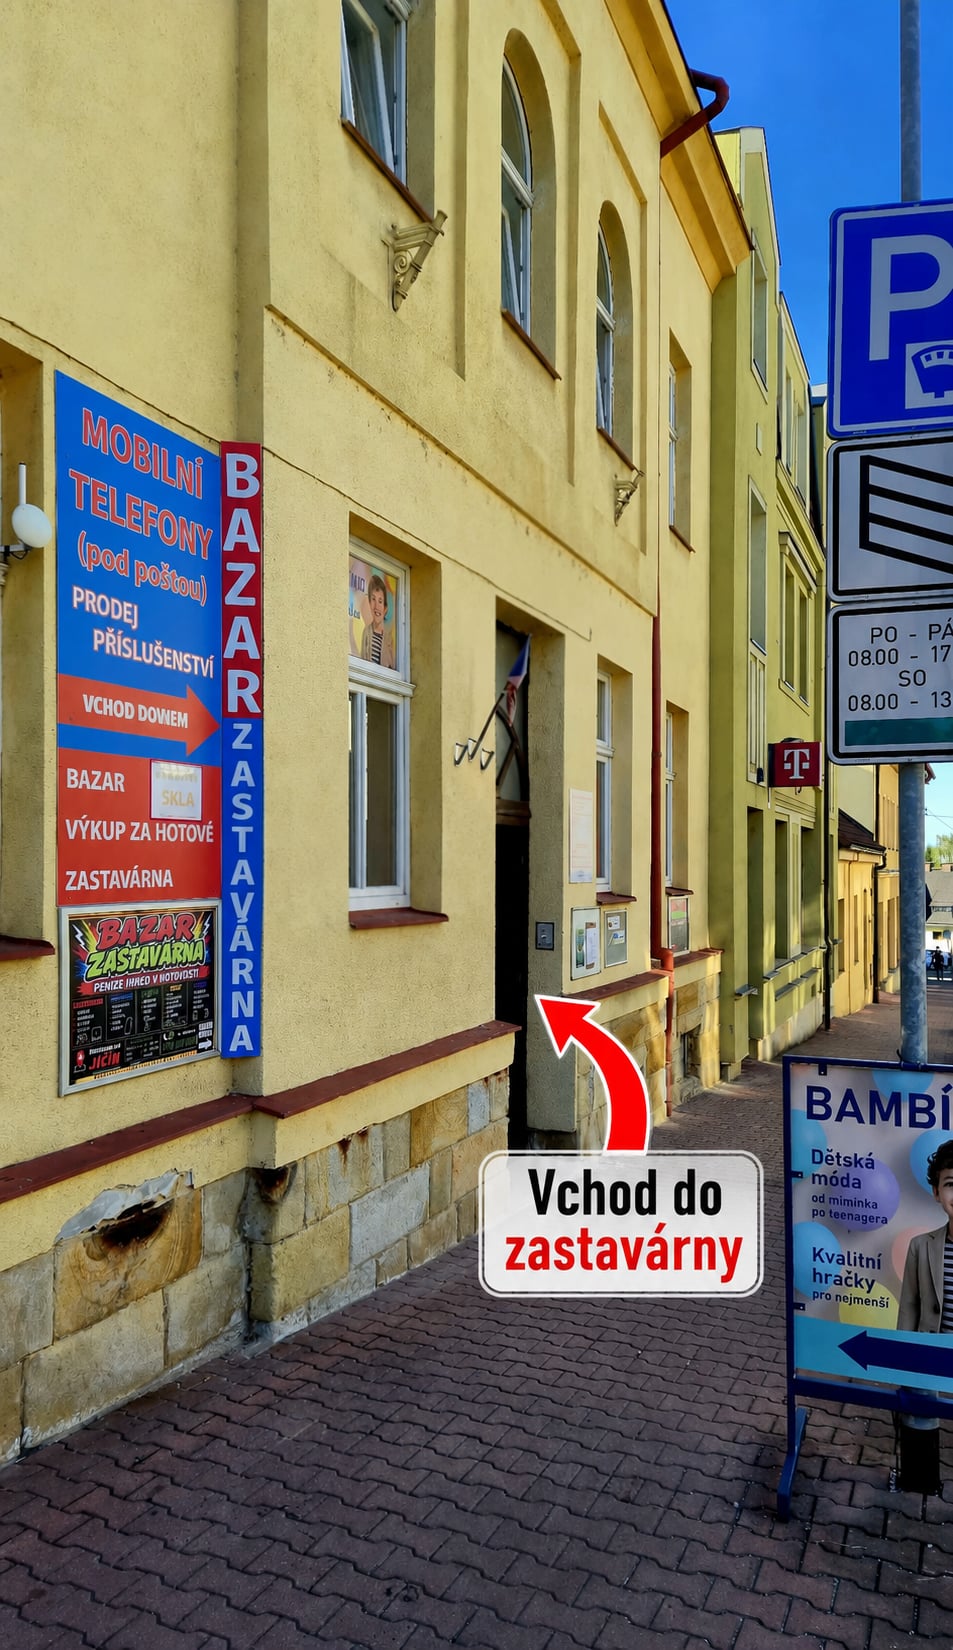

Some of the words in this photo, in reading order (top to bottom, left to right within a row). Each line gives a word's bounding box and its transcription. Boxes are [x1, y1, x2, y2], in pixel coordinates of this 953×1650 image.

[869, 234, 953, 361] P
[69, 469, 213, 560] TELEFONY
[78, 530, 129, 577] (pod
[135, 561, 207, 607] poštou)
[223, 453, 262, 714] BAZAR
[72, 585, 138, 631] PRODEJ
[871, 626, 898, 644] PO
[928, 618, 953, 641] PÁ
[93, 626, 214, 680] PŘÍSLUŠENSTVÍ
[848, 648, 899, 667] 08.00
[931, 645, 952, 663] 17
[898, 669, 926, 687] SO
[82, 694, 135, 720] VCHOD
[848, 693, 899, 712] 08.00
[931, 691, 952, 708] 13
[784, 749, 809, 779] T
[66, 768, 126, 792] BAZAR
[65, 815, 126, 841] VÝKUP
[130, 821, 151, 841] ZA
[156, 821, 214, 843] HOTOVÉ
[65, 865, 173, 891] ZASTAVÁRNA
[229, 723, 256, 1051] ZASTAVÁRNA
[97, 913, 196, 950] BAZAR
[806, 1083, 953, 1131] BAMBÍ
[811, 1148, 875, 1171] Dětská
[811, 1170, 862, 1190] móda
[811, 1194, 825, 1205] od
[828, 1195, 878, 1210] miminka
[811, 1208, 825, 1219] po
[828, 1207, 888, 1225] teenagera
[812, 1246, 882, 1271] Kvalitní
[812, 1268, 876, 1293] hračky
[812, 1290, 831, 1304] pro
[835, 1292, 890, 1308] nejmenší
